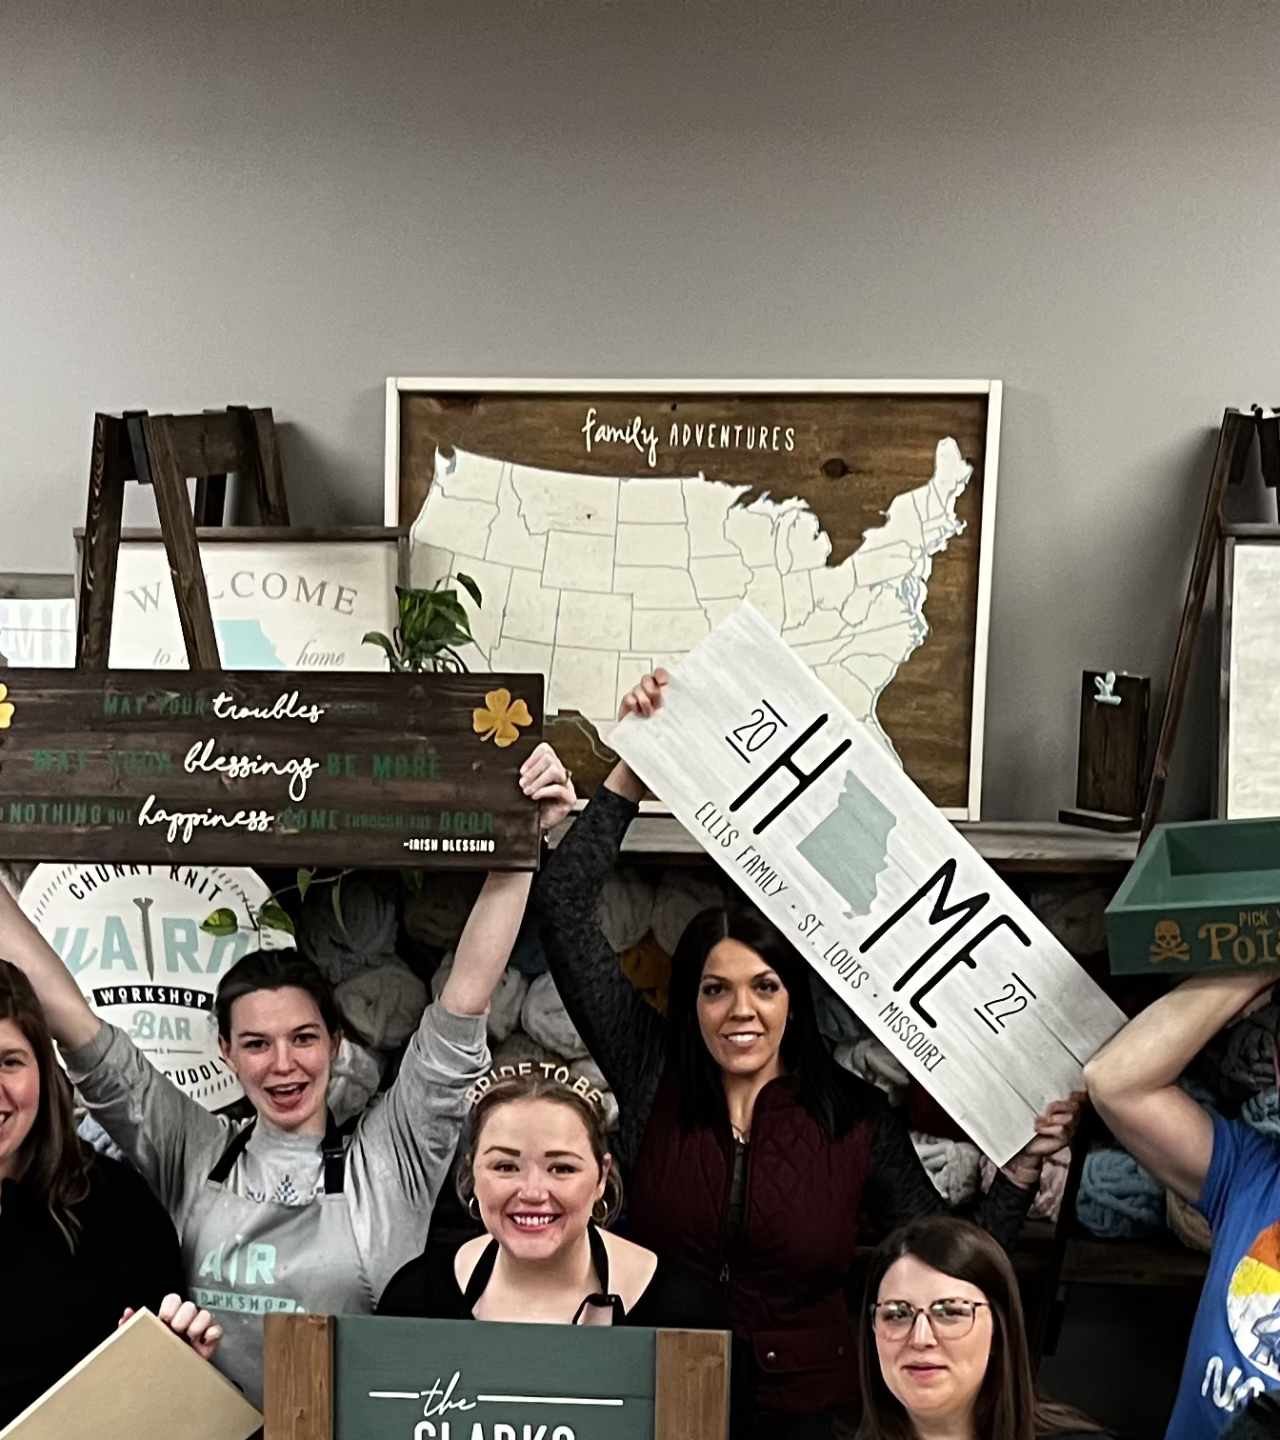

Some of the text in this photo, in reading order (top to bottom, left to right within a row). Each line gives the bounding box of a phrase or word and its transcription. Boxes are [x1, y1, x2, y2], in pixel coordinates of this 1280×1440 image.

[581, 409, 797, 469] family ADVENTURES
[295, 638, 346, 667] home
[211, 690, 326, 724] troubles
[732, 709, 780, 753] 20
[184, 738, 320, 802] blessings
[138, 794, 274, 844] happiness
[441, 838, 496, 854] BLESSING
[693, 799, 948, 1075] ELLIS FAMILY ST. LOUIS MISSOURI
[1238, 909, 1268, 928] PICK
[100, 986, 208, 1007] WORKSHOP
[983, 982, 1029, 1030] 22
[131, 1010, 193, 1041] BAR
[539, 1061, 570, 1084] TO
[573, 1074, 605, 1106] BE
[420, 1370, 477, 1419] the
